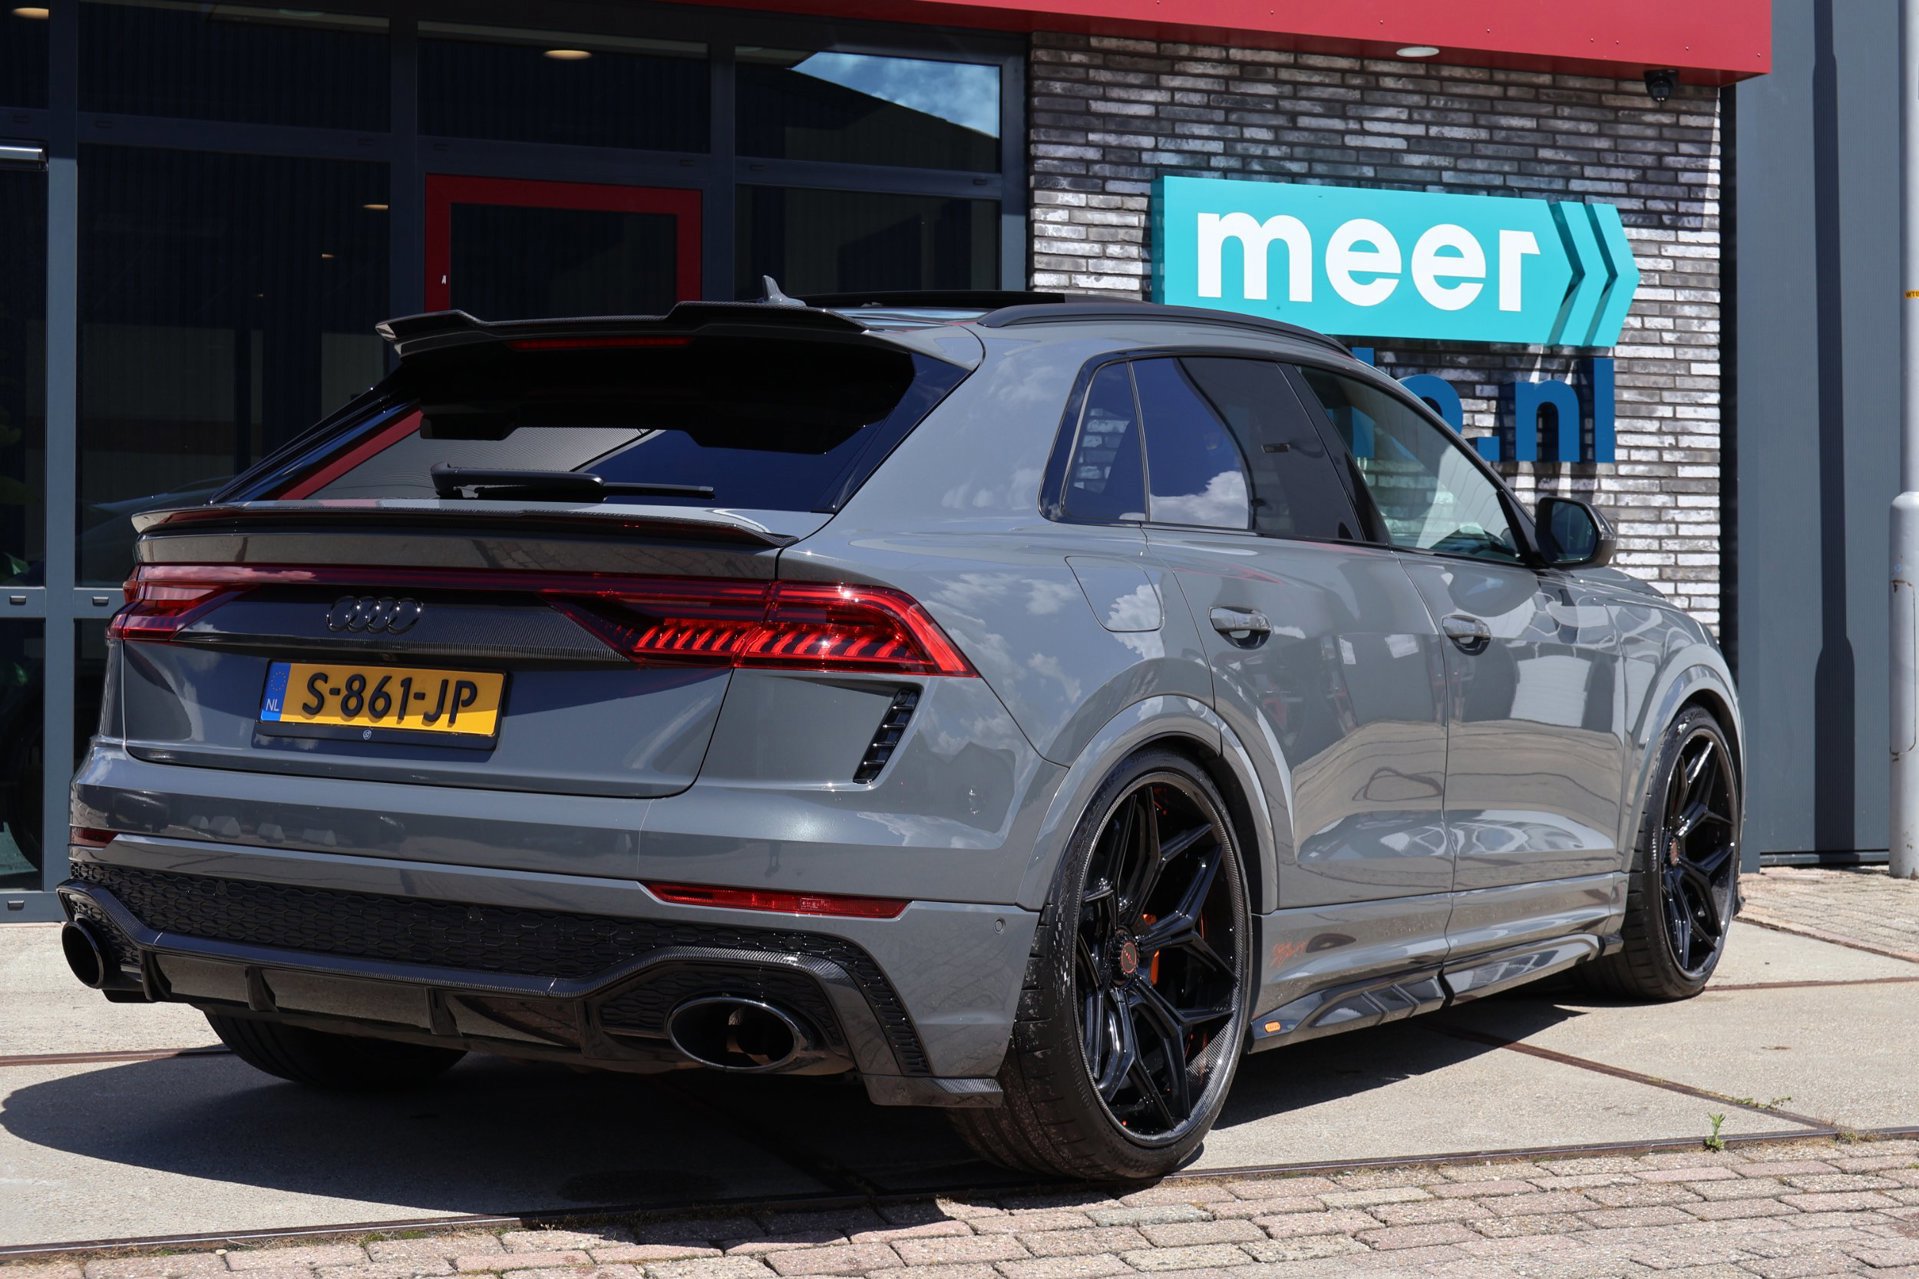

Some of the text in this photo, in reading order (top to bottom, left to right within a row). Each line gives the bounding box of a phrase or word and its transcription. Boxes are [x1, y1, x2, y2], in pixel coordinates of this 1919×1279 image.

[1198, 212, 1541, 311] meer
[266, 698, 280, 712] NL
[301, 672, 478, 724] S-861-JP
